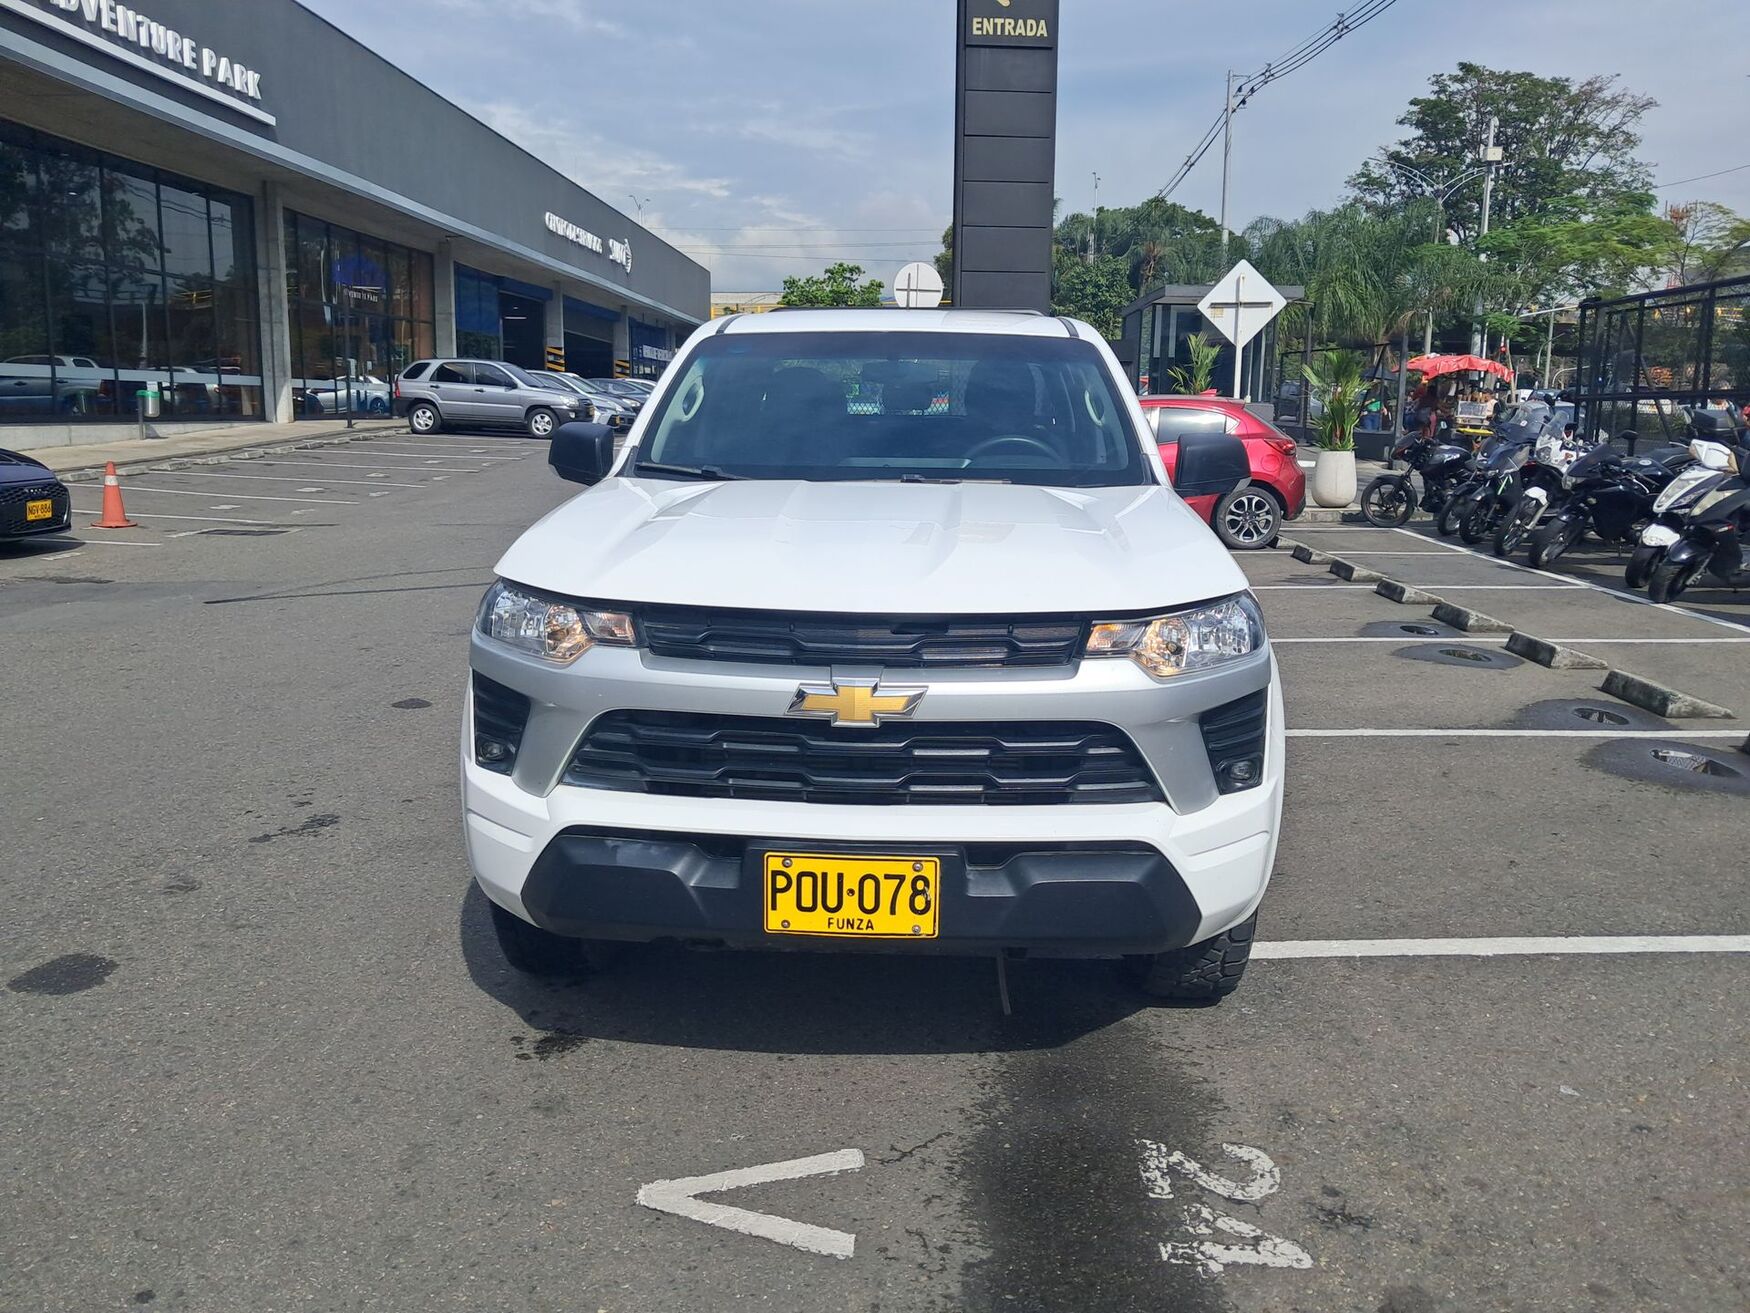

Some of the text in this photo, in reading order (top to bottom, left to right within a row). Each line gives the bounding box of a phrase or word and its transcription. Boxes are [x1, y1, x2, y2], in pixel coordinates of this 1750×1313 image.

[972, 17, 1048, 37] ENTRADA
[202, 47, 262, 100] PARK
[827, 917, 874, 931] FUNZA
